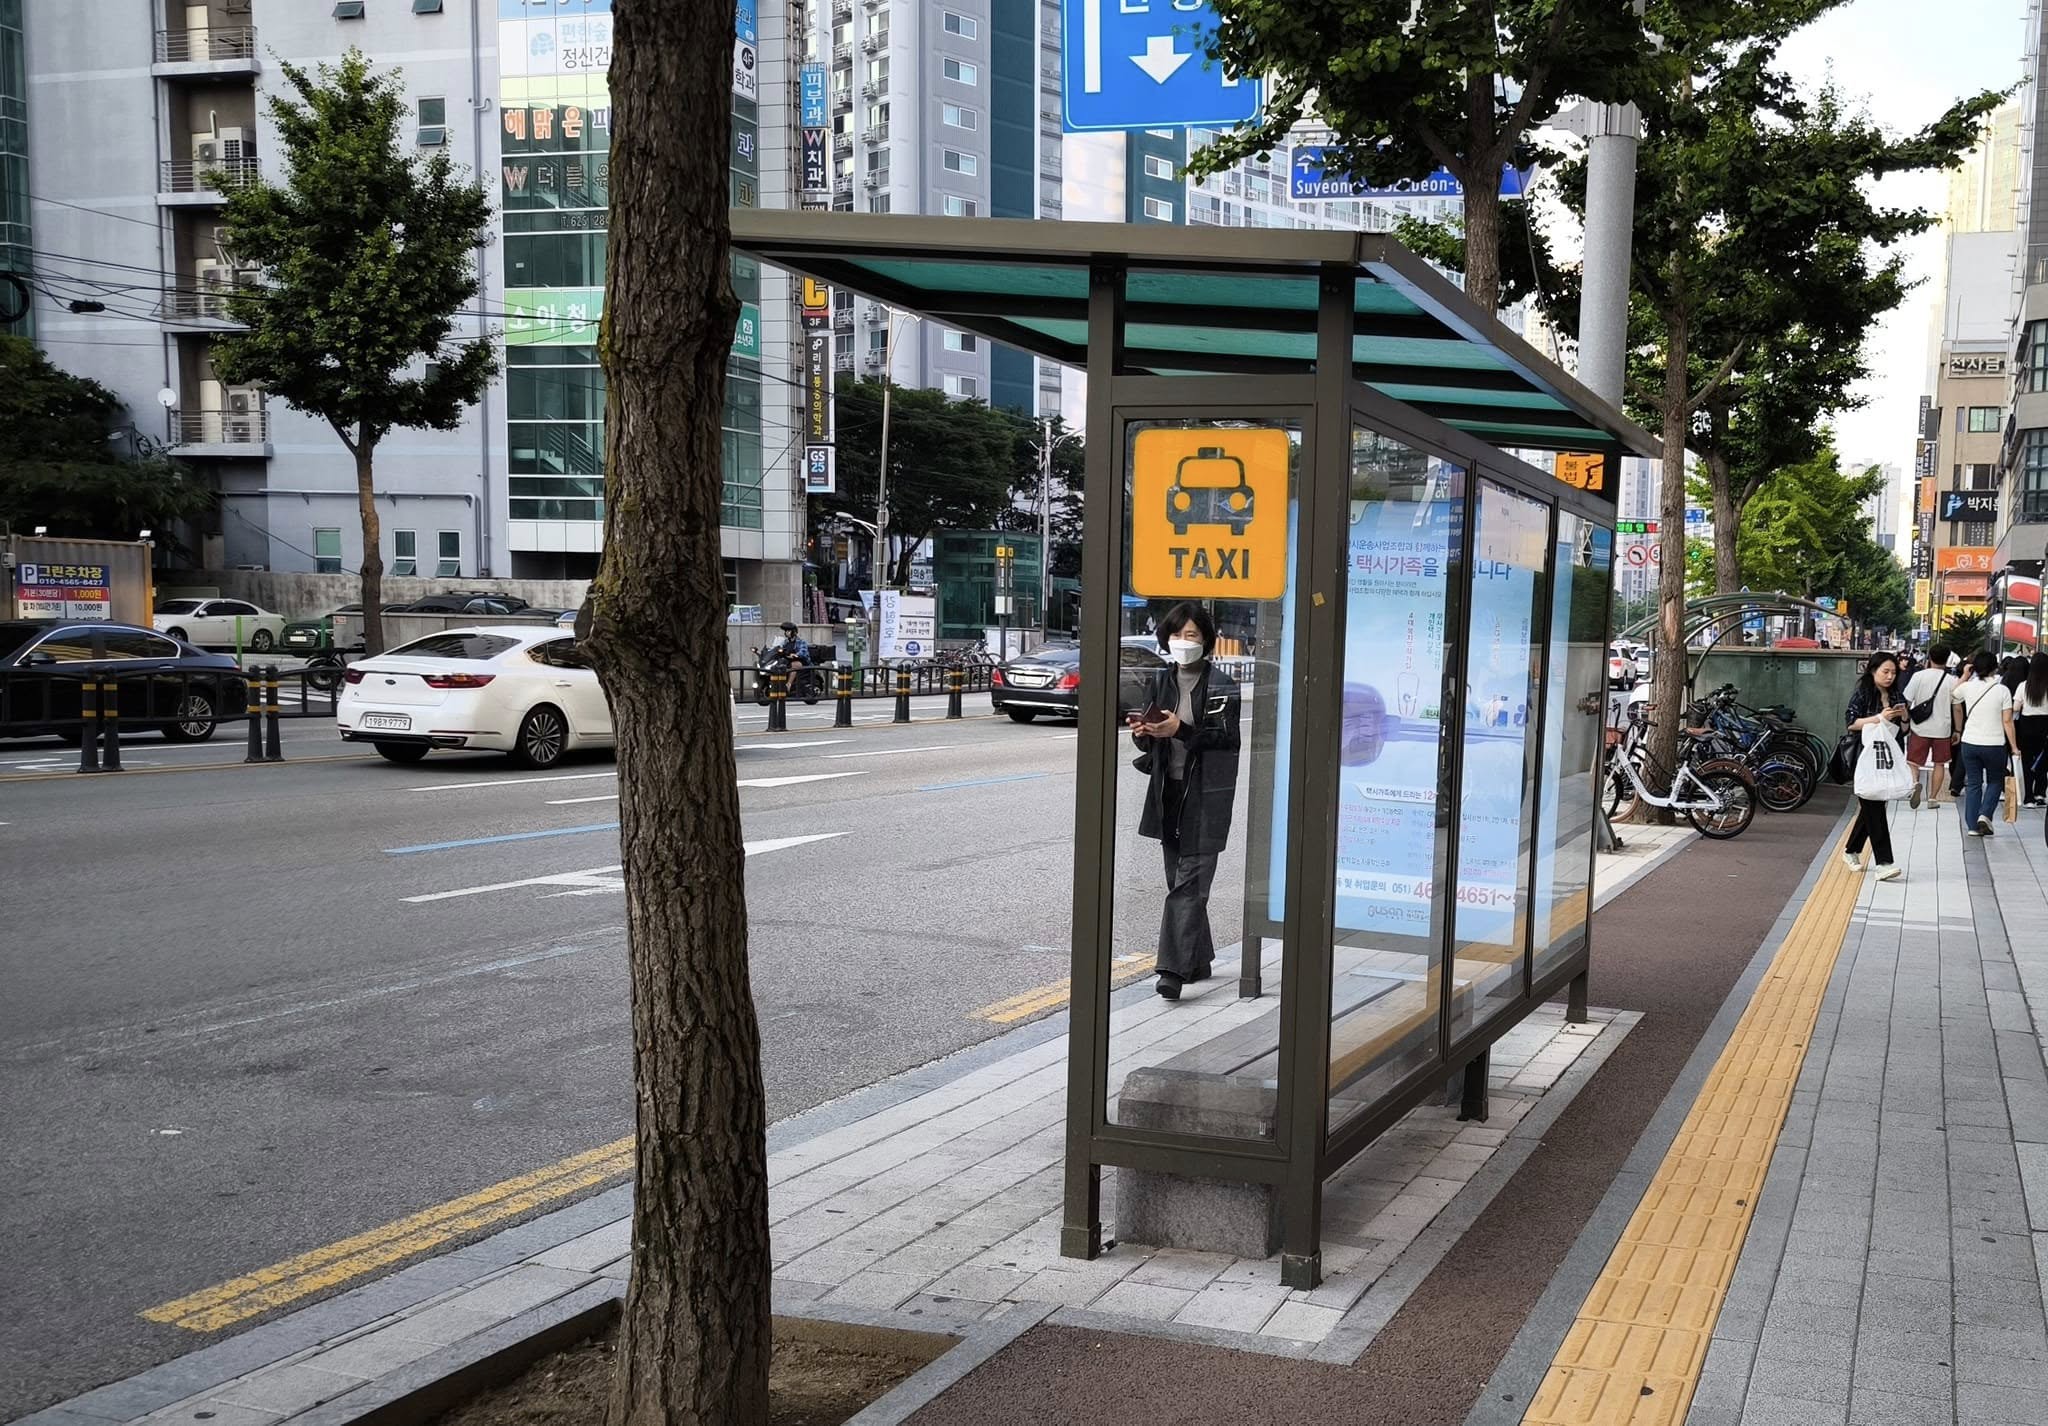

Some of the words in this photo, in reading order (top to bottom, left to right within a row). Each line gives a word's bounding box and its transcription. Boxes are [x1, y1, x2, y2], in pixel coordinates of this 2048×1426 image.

[806, 72, 823, 121] 피부과
[504, 106, 583, 140] 해맑은
[804, 130, 824, 147] W
[807, 150, 824, 182] 치과
[508, 303, 602, 334] 소아청
[1951, 356, 2003, 373] 전자담
[810, 451, 826, 461] GS
[811, 462, 826, 473] 25
[38, 565, 103, 579] 그린주차장
[1169, 548, 1250, 579] TAXI
[1356, 555, 1439, 577] 택시가족을
[73, 589, 102, 599] 1,000원
[1355, 879, 1387, 892] 취업문의
